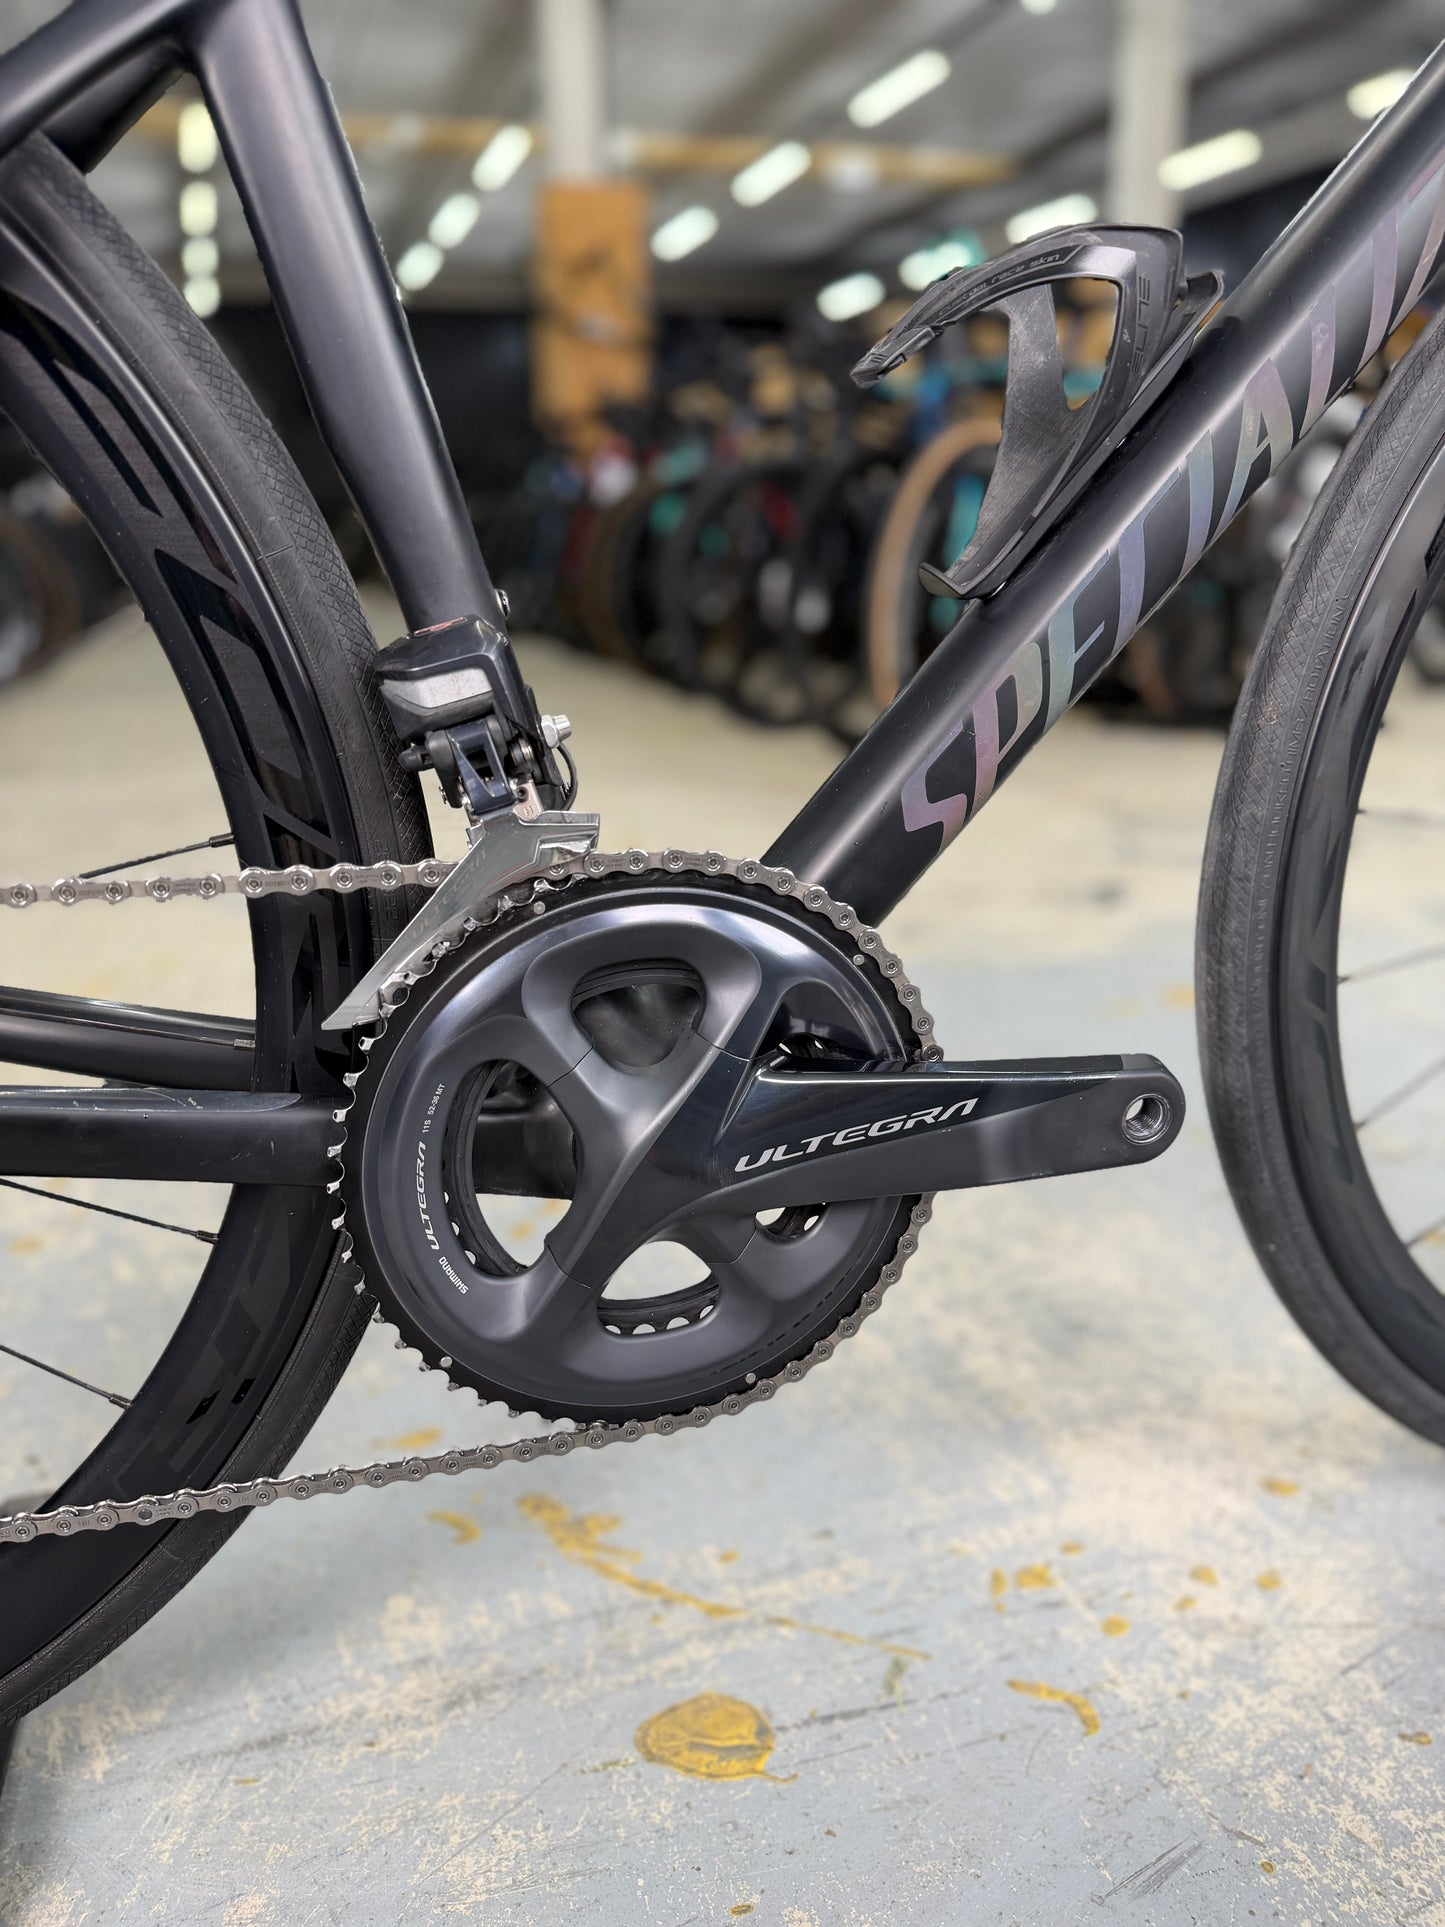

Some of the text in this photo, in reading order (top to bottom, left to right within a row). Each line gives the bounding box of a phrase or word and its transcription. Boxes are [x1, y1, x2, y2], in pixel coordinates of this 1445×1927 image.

[990, 264, 1025, 287] race
[1029, 253, 1060, 268] skin
[1131, 276, 1151, 374] ELITE
[1303, 605, 1345, 702] ROTATION
[734, 1097, 979, 1172] ULTEGRA
[415, 1141, 440, 1250] ULTEGRA
[438, 1256, 469, 1295] SHIMANO
